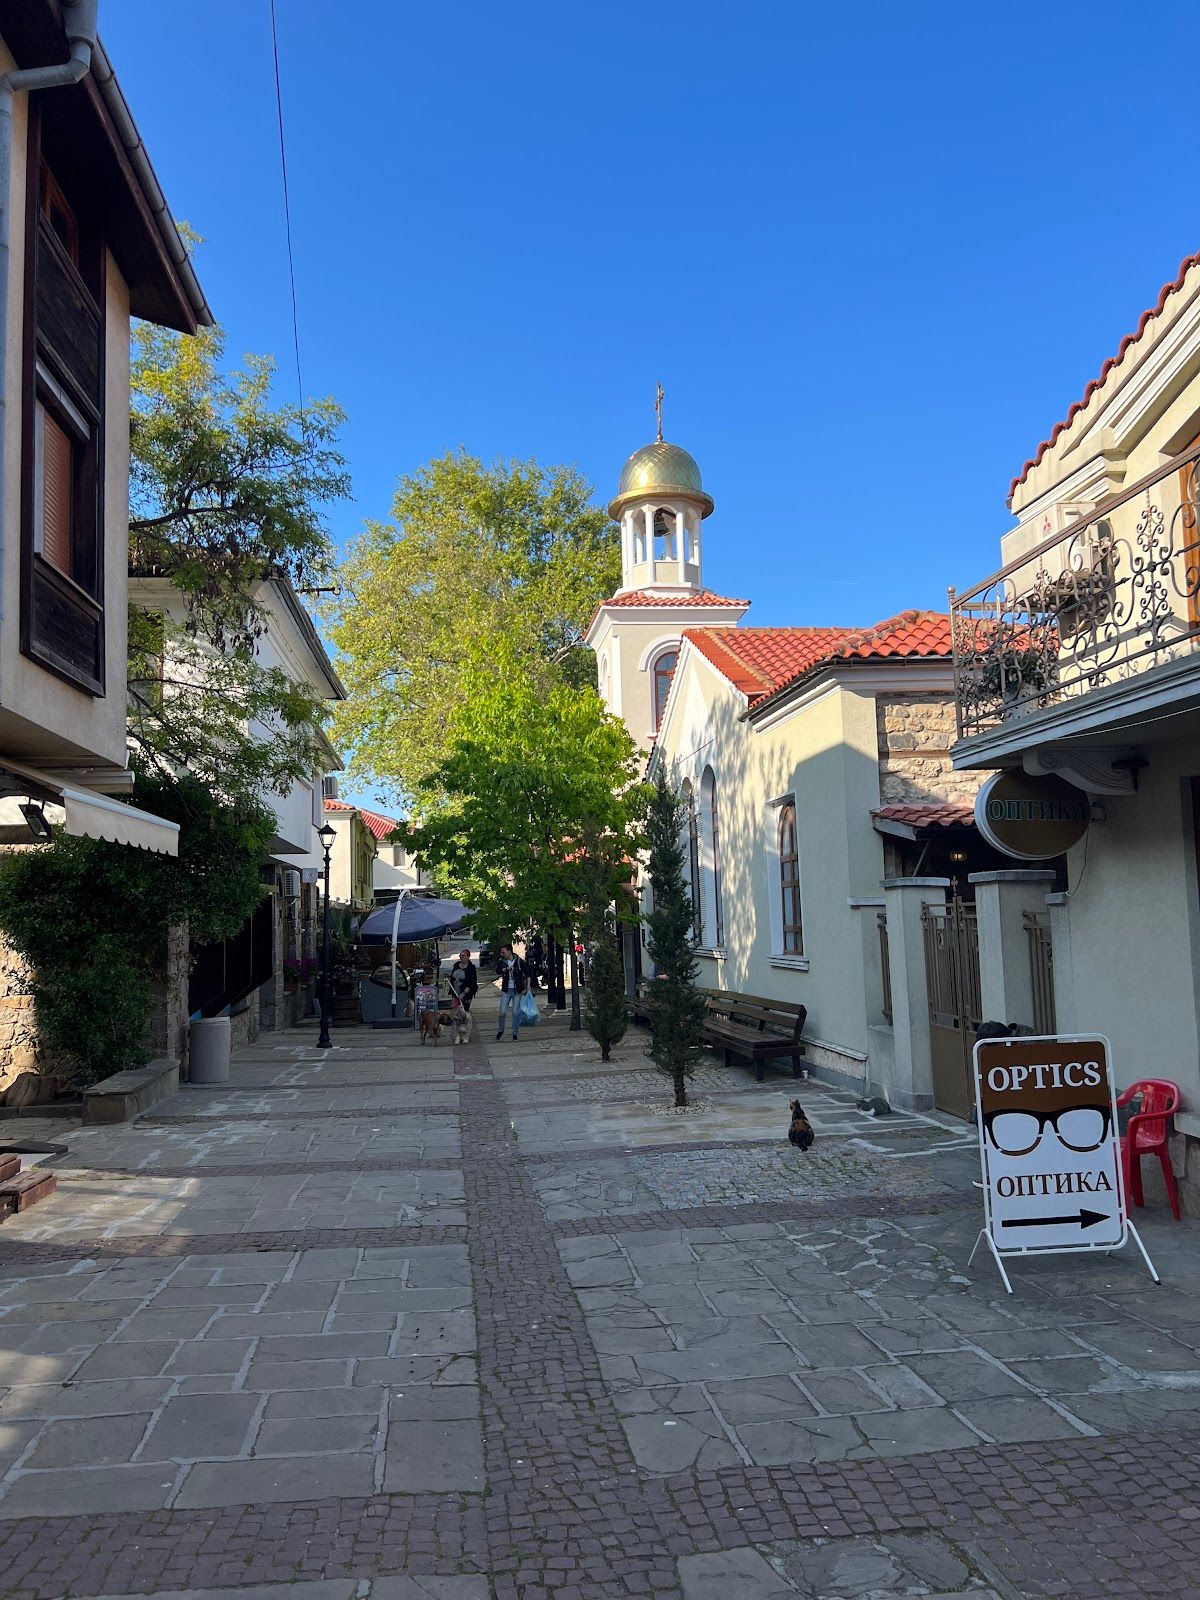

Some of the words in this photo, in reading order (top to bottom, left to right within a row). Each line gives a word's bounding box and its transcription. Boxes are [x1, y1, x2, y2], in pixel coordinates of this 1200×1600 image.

[988, 799, 1088, 821] ОПТИКА
[987, 1061, 1102, 1092] OPTICS
[996, 1170, 1114, 1198] ОПТИКА
